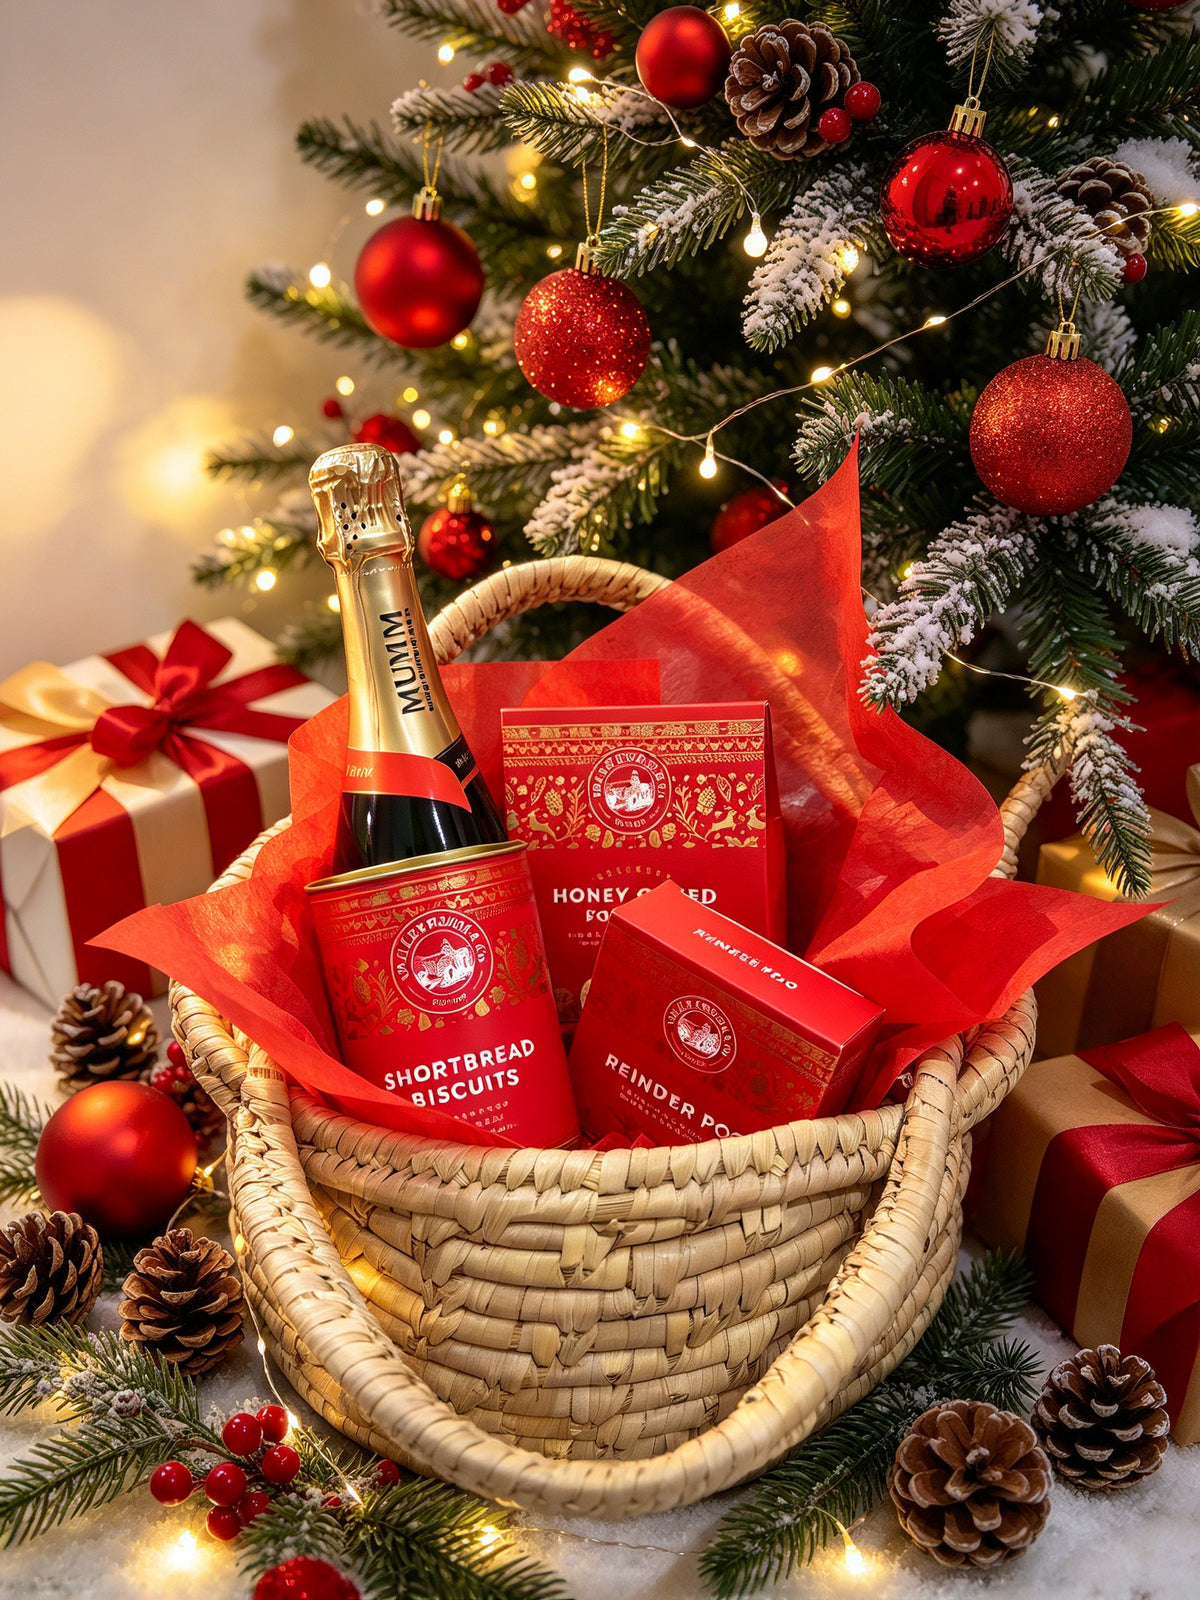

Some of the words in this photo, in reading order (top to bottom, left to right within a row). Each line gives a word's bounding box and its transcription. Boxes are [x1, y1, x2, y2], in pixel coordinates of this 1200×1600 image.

[379, 610, 425, 715] MUMM
[553, 887, 629, 904] HONEY
[384, 1038, 535, 1091] SHORTBREAD
[411, 1068, 520, 1108] BISCUITS
[604, 1053, 695, 1120] REINDER
[700, 1112, 744, 1138] PO
